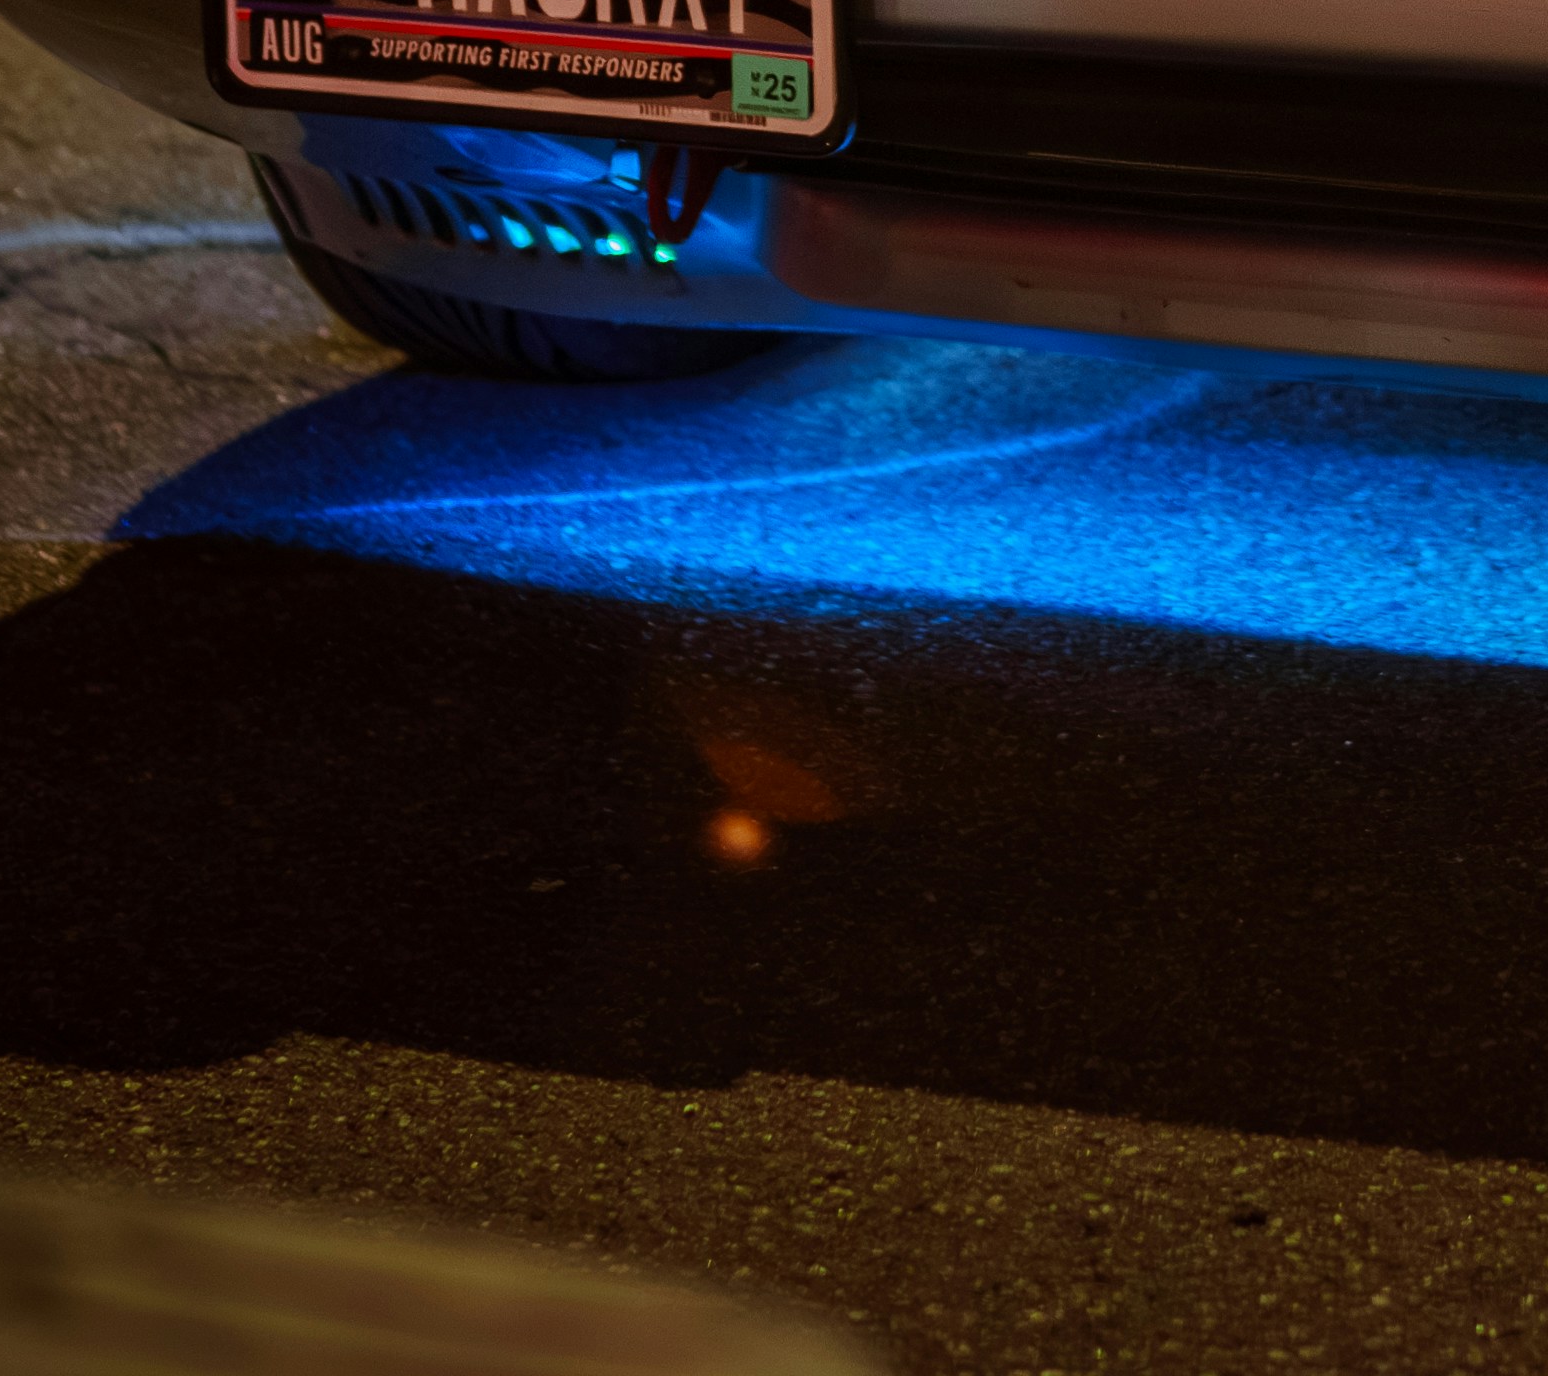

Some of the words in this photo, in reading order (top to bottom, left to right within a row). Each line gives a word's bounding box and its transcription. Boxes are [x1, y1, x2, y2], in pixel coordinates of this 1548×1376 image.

[262, 17, 323, 66] AUG
[369, 37, 492, 67] SUPPORTING
[498, 47, 552, 71] FIRST
[557, 54, 684, 83] RESPONDERS
[763, 72, 797, 103] 25
